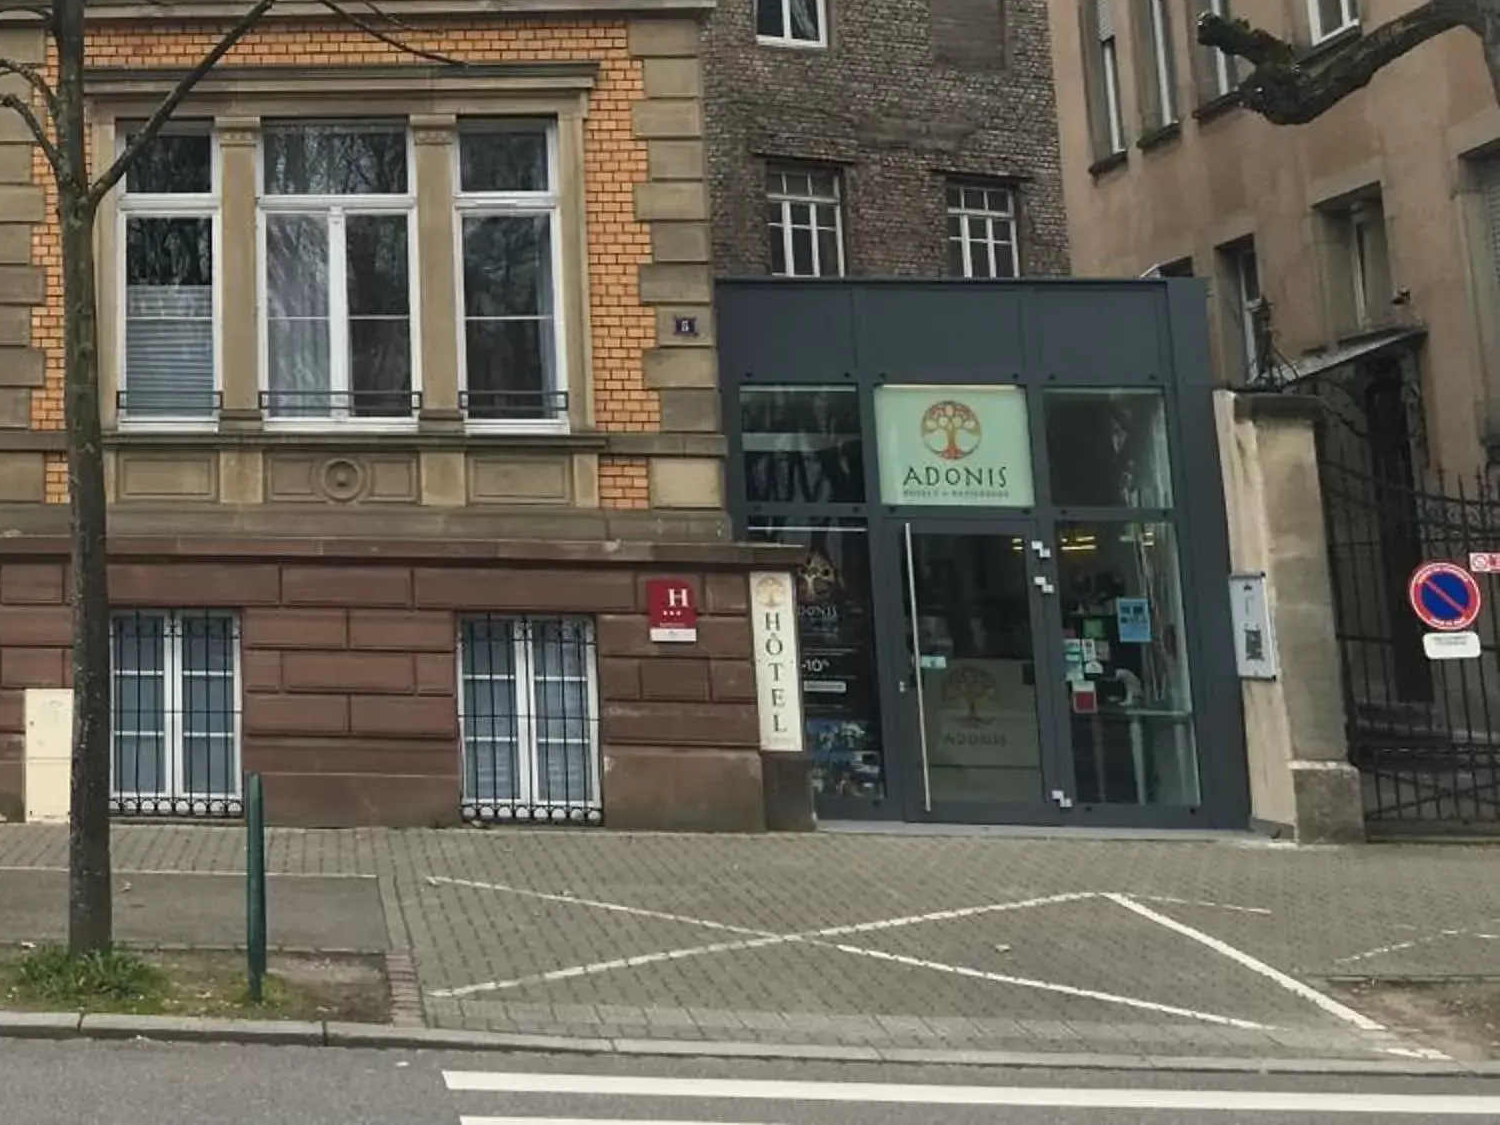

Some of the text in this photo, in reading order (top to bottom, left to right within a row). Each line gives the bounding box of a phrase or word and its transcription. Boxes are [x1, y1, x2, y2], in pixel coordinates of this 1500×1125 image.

[902, 466, 1007, 488] ADONIS
[668, 588, 689, 607] H
[764, 612, 788, 733] HÔTEL
